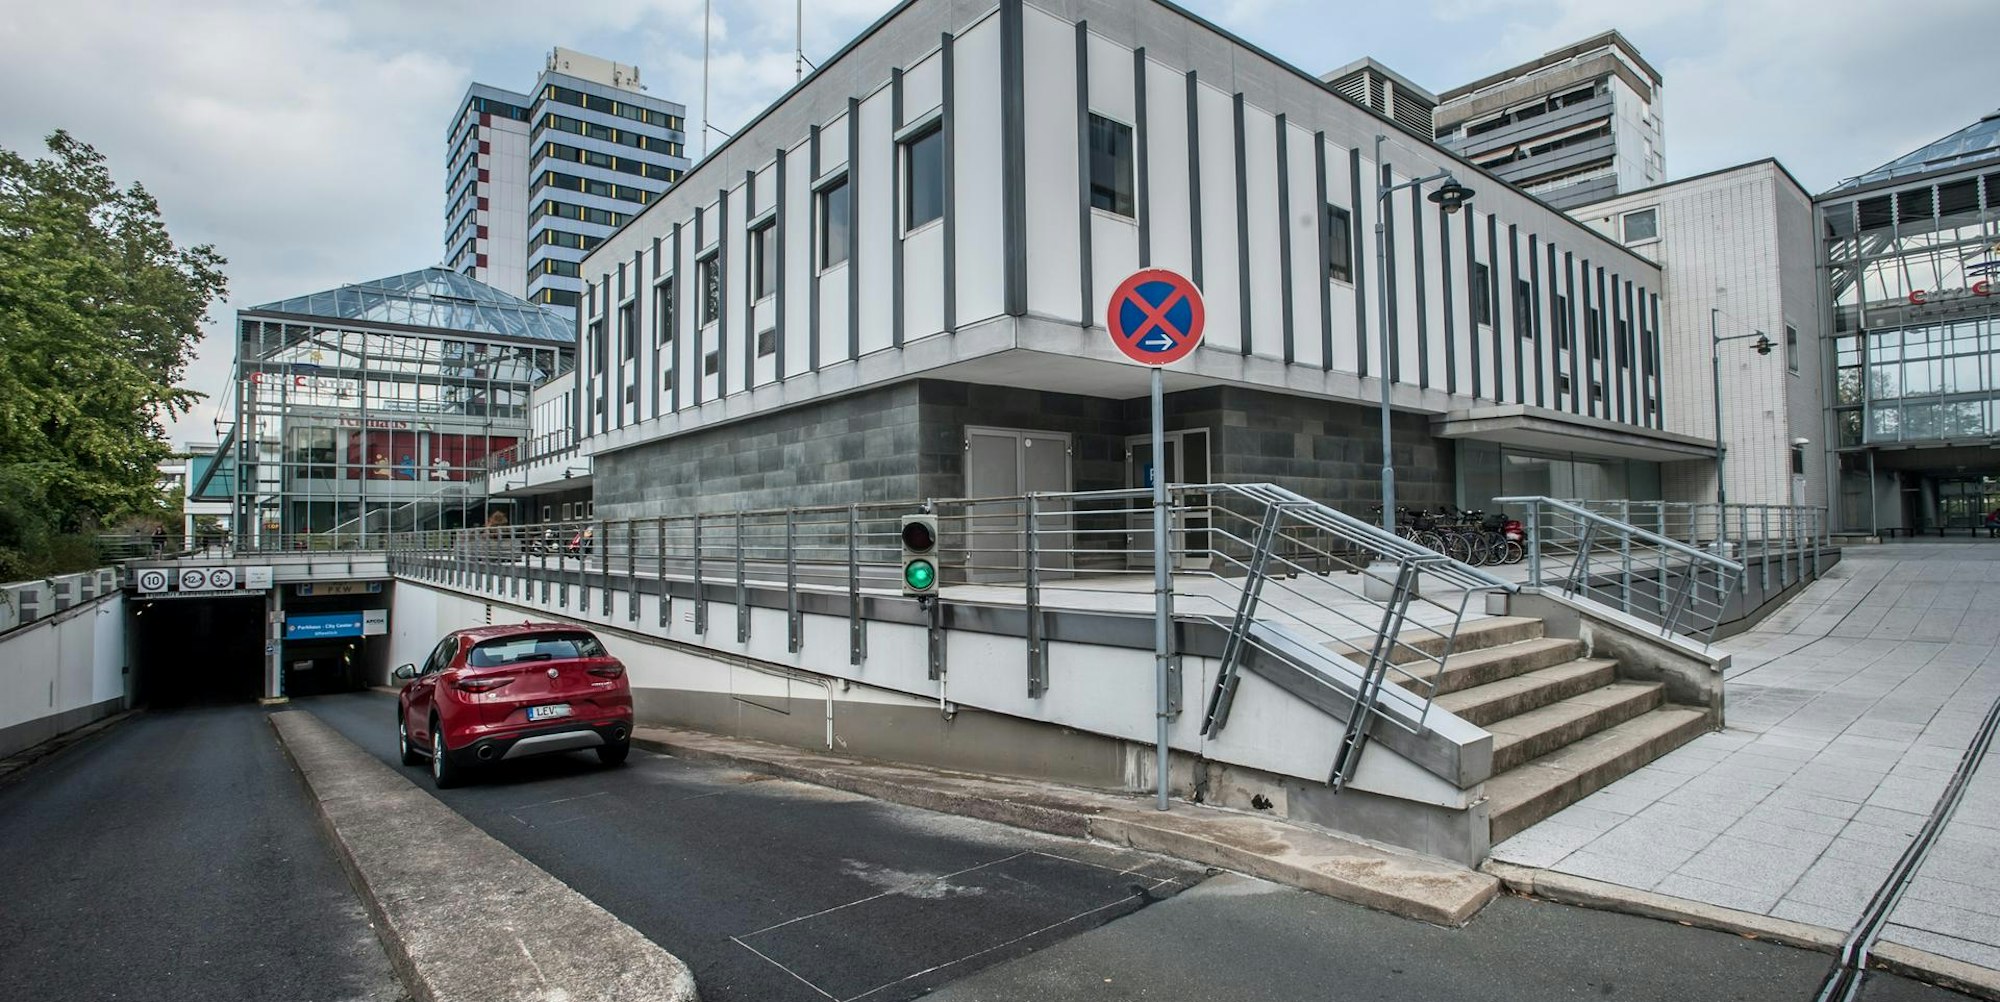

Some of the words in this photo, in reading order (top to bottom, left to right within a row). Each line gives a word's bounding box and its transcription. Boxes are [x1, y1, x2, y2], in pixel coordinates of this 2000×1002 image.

[147, 576, 160, 586] 10
[325, 622, 335, 630] City
[537, 706, 555, 716] LEV
